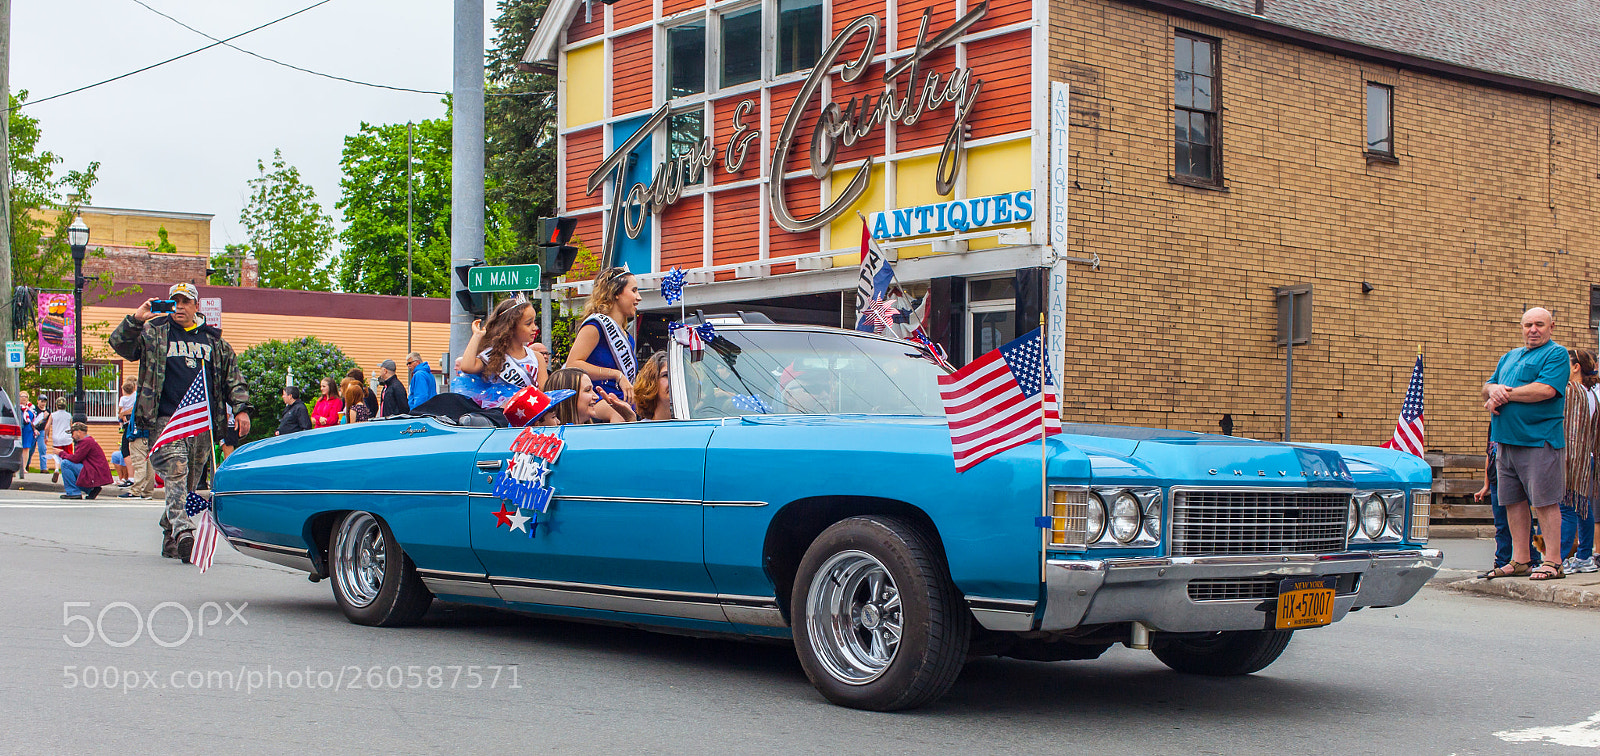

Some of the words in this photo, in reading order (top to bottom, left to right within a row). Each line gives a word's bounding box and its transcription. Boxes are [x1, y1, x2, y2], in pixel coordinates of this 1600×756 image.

[587, 101, 718, 271] Town
[725, 99, 762, 174] &
[769, 1, 989, 234] Country
[1054, 89, 1067, 243] ANTIQUES
[871, 190, 1034, 240] ANTIQUES
[475, 272, 483, 287] N
[490, 270, 519, 286] MAIN
[525, 276, 533, 285] ST
[598, 314, 620, 341] SPIRIT
[40, 346, 67, 360] Liberty
[166, 340, 212, 362] ARMY
[614, 340, 627, 352] OF
[620, 350, 633, 370] THE
[1294, 581, 1309, 590] NEW
[1310, 580, 1325, 588] YORK
[1301, 591, 1331, 617] 57007
